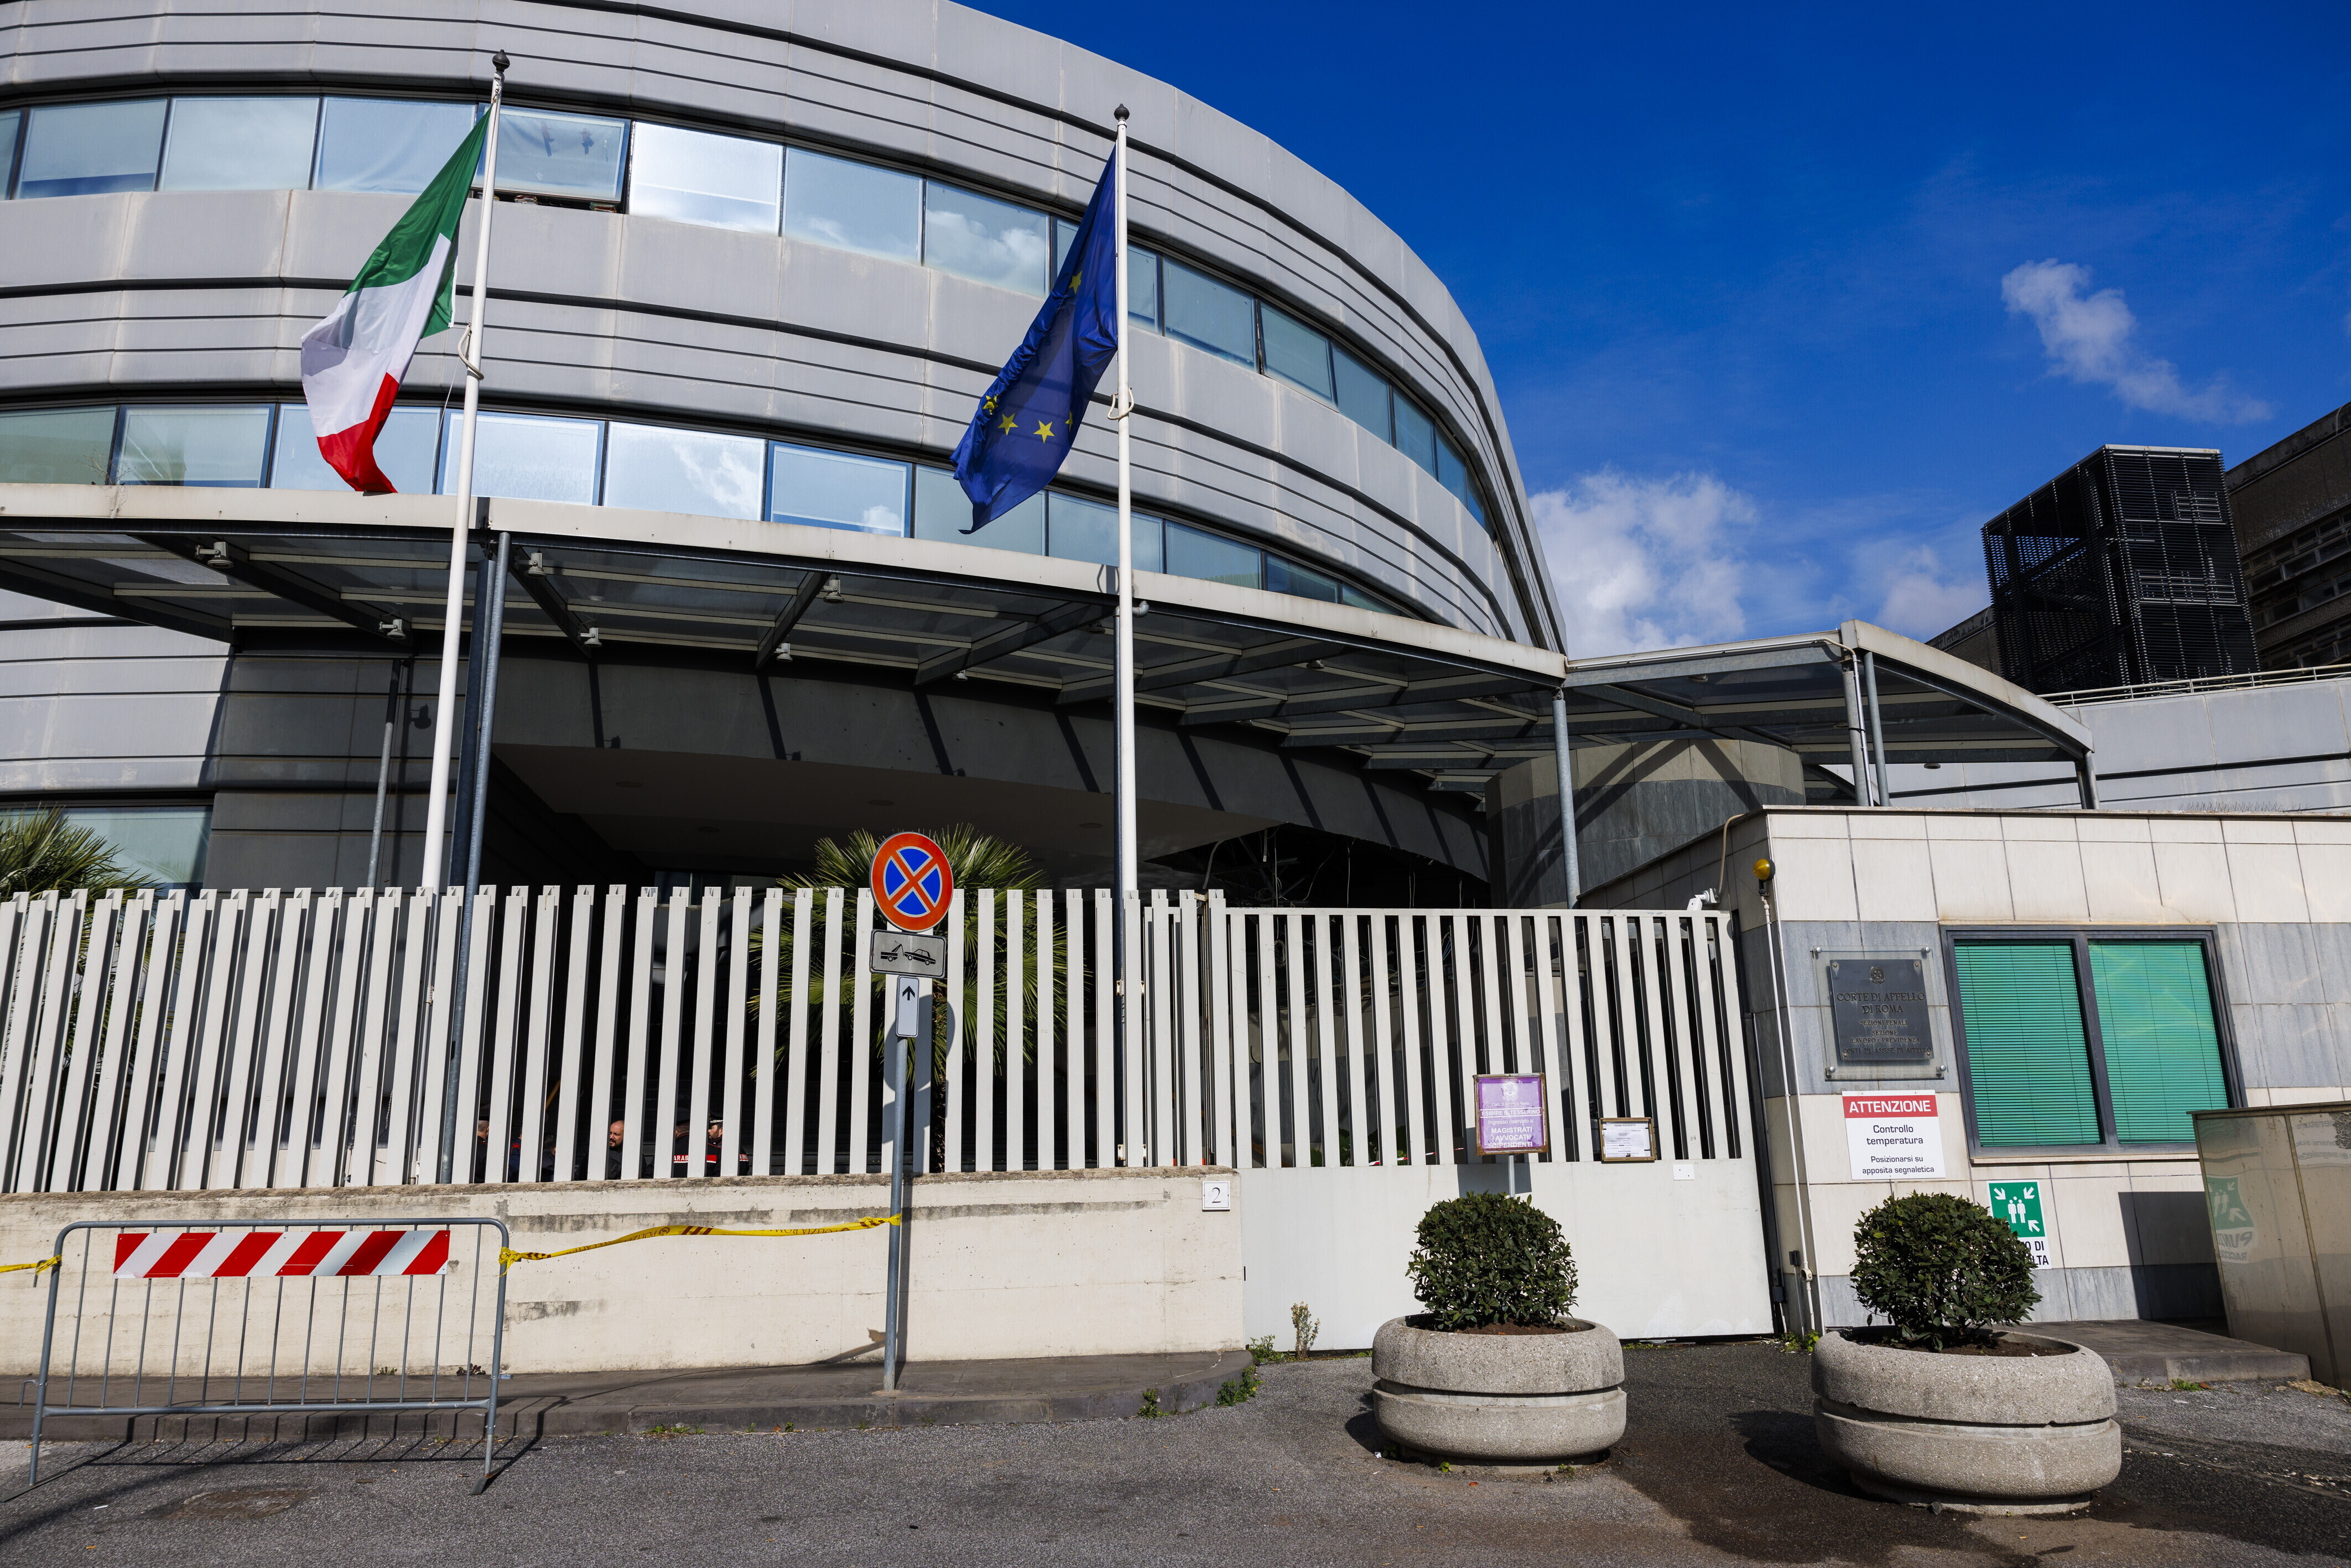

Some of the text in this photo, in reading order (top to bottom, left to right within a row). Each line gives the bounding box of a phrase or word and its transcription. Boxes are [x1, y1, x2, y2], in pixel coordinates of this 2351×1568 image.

[1837, 992, 1925, 1001] CORTE DI APPELLO
[1862, 1004, 1903, 1014] DI ROMA
[1849, 1100, 1931, 1113] ATTENZIONE
[1873, 1124, 1913, 1133] Controllo
[1866, 1137, 1923, 1147] temperatura
[1862, 1166, 1934, 1175] apposita segnaletica
[1212, 1187, 1221, 1203] 2
[2035, 1241, 2045, 1251] DI
